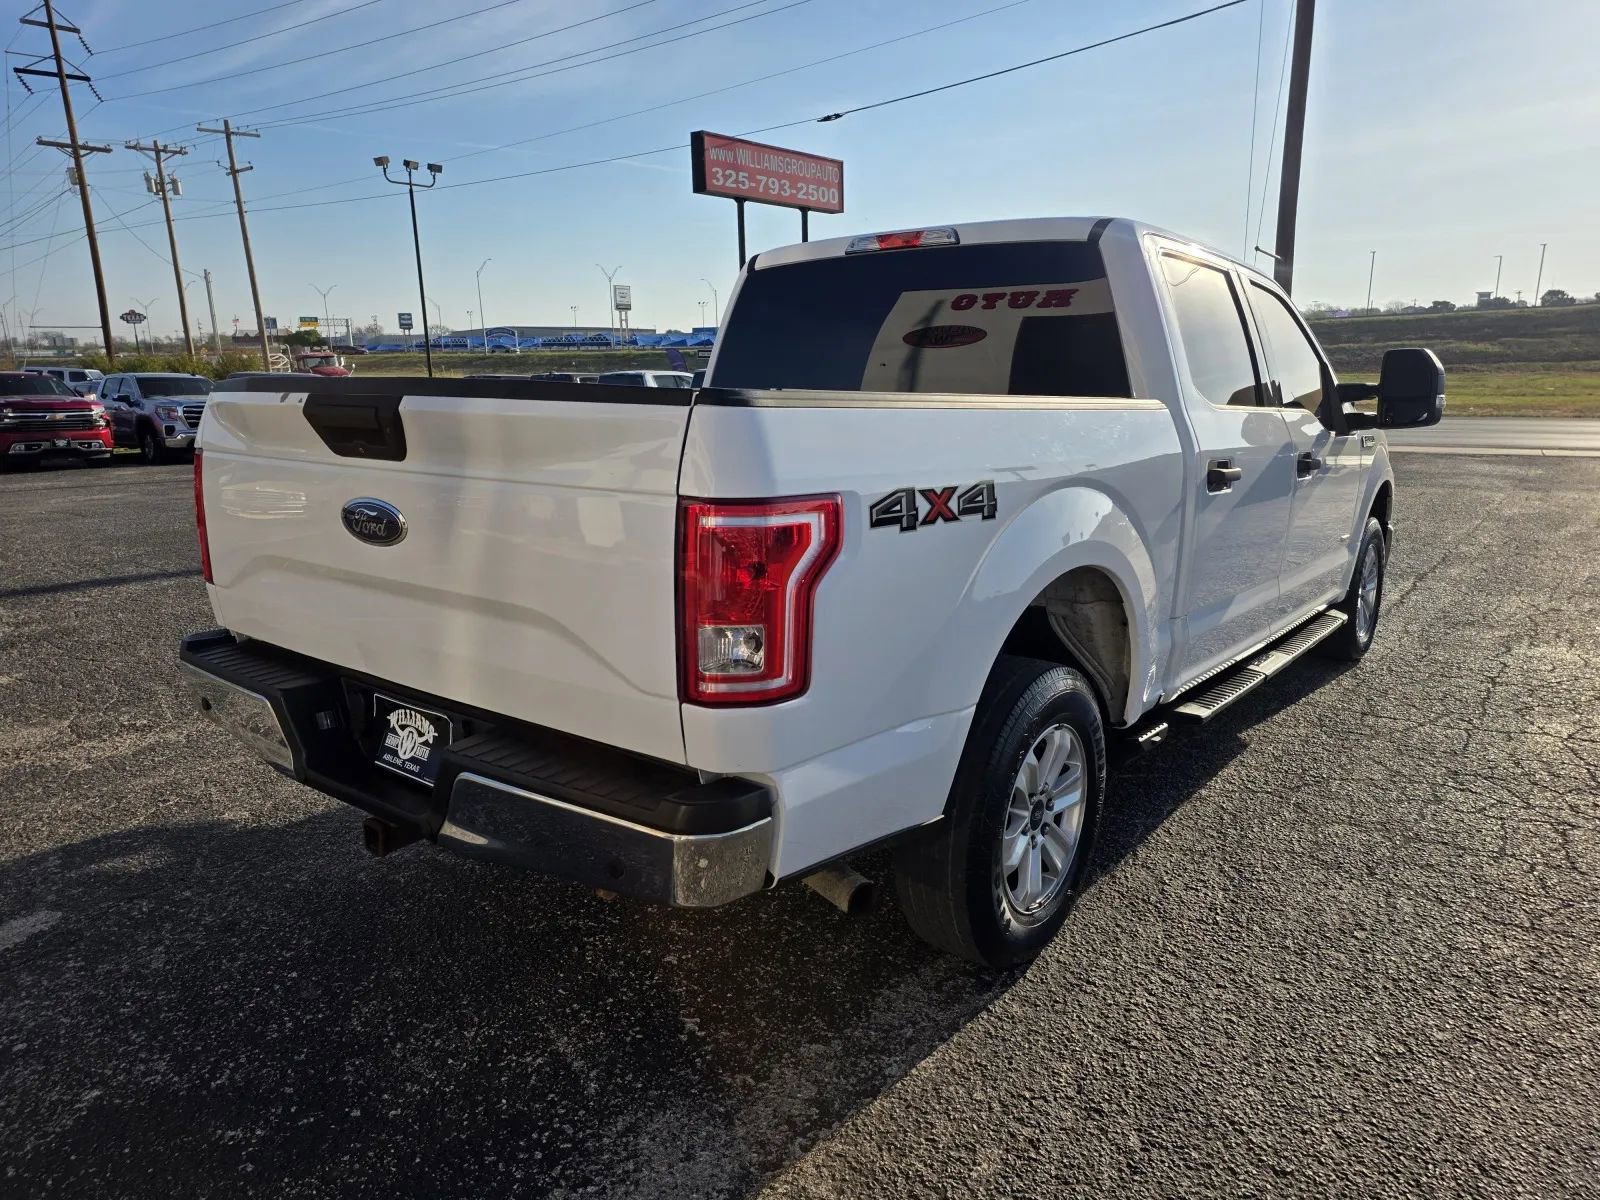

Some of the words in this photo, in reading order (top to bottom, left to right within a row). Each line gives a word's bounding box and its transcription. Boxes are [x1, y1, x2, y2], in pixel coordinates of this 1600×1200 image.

[712, 167, 838, 204] 325-793-2500
[353, 508, 387, 536] Ford
[387, 709, 438, 744] WILLIAMS
[382, 753, 404, 767] ABILENE,
[404, 761, 420, 773] TEXAS
